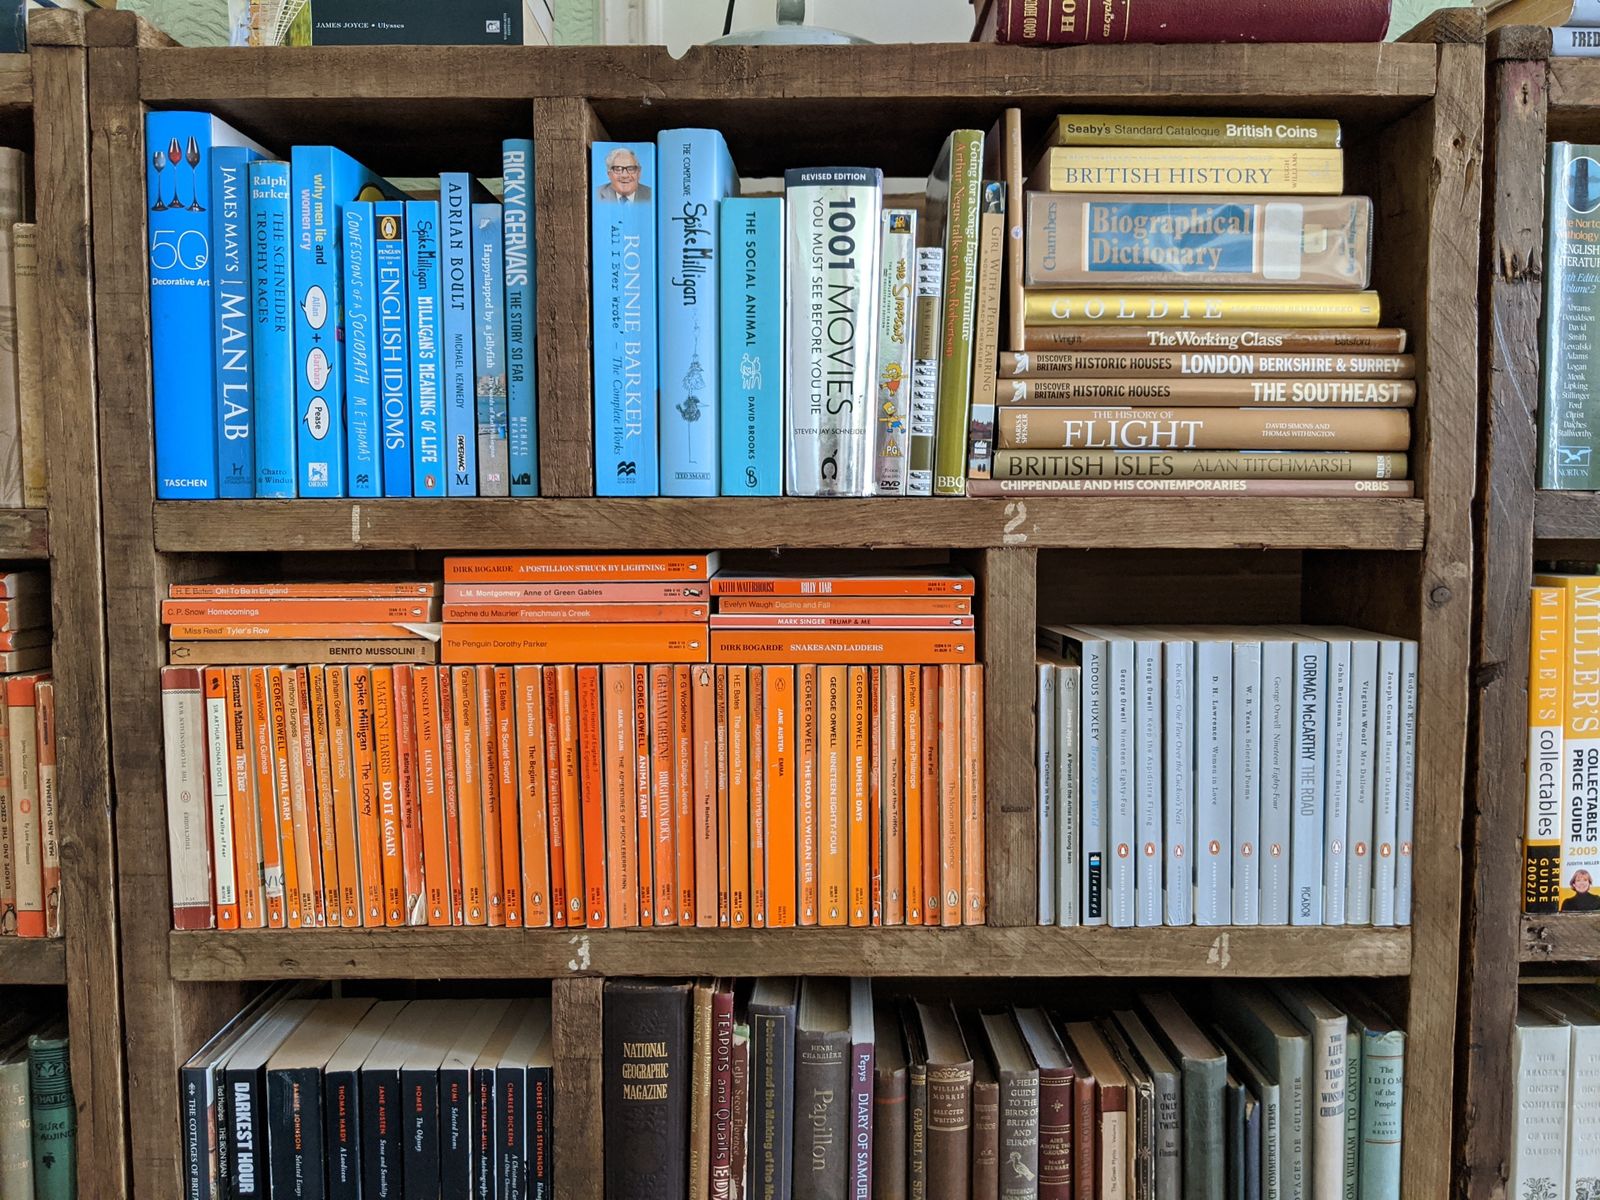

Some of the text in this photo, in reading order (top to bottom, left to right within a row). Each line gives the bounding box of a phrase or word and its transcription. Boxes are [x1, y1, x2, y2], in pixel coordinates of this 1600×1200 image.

[1067, 123, 1318, 138] Seaby's Standard Catalogue British Coins
[253, 176, 287, 188] Ralph
[801, 172, 866, 181] REVISED EDITION
[1065, 167, 1273, 184] BRITISH HISTORY
[311, 174, 328, 265] why men lie and
[503, 151, 528, 287] RICKY GERVAIS
[1092, 206, 1250, 240] Biographical
[448, 182, 465, 311] ADRIAN BOULT
[1092, 237, 1223, 271] Dictionary
[152, 277, 210, 287] Decorative Art
[256, 212, 269, 324] TROPHY RACES
[273, 212, 287, 332] THE SCHNEIDER
[745, 212, 756, 347] THE SOCIAL ANIMAL
[220, 167, 249, 440] JAMES MAY'S MAN LAB
[810, 197, 824, 415] YOU MUST SEE BEFORE YOU DIE
[826, 197, 856, 415] 1001 MOVIES
[623, 235, 642, 439] RONNIE BARKER
[1334, 337, 1371, 347] batsford
[1568, 323, 1587, 331] David
[381, 268, 405, 450] ENGLISH IDIOMS
[454, 333, 465, 409] MICHAEL KENNEDY
[1075, 357, 1172, 370] HISTORIC HOUSES
[1566, 362, 1587, 373] Logan
[417, 296, 438, 463] MILLIGAN'S MEANING OF LIFE
[1073, 385, 1171, 398] HISTORIC HOUSES
[1251, 382, 1401, 403] THE SOUTHEAST
[314, 406, 323, 430] Pease
[747, 425, 755, 460] BROOKS
[1062, 420, 1203, 449] FLIGHT
[1009, 455, 1174, 476] BRITISH ISLES
[1193, 458, 1352, 473] ALAN TITCHMARSH
[164, 479, 208, 487] TASCHEN
[937, 476, 965, 488] BBC
[1000, 479, 1247, 491] CHIPPENDALE AND HIS CONTEMPORARIES
[1354, 481, 1390, 491] ORBIS
[453, 565, 514, 573] DIRK BOGARDE
[329, 647, 416, 656] BENITO MUSSOLINI
[447, 640, 548, 649] The Penguin Dorothy Parker
[1090, 653, 1099, 741] ALDOUS HUXLEY
[1539, 592, 1559, 837] MILLER'S collectables
[272, 676, 291, 821] GEORGE ORWELL ANIMAL FARM
[637, 673, 648, 818] GEORGE ORWELL ANIMAL FARM
[1301, 654, 1318, 817] CORMAC McCARTHY THE ROAD
[45, 777, 54, 817] SUPERMAN
[1571, 749, 1583, 843] PRICE GUIDE
[1587, 747, 1598, 842] COLLECTABLES
[48, 839, 56, 857] MAN
[1568, 846, 1598, 856] 2009
[1090, 869, 1099, 915] flamingo
[1527, 858, 1536, 903] 2002/3
[1539, 858, 1548, 904] GUIDE
[1552, 857, 1561, 902] PRICE
[1300, 886, 1311, 918] PICADOR
[623, 1041, 668, 1058] NATIONAL
[622, 1062, 669, 1080] GEOGRAPHIC
[714, 1012, 731, 1160] TEAPOTS and Quails
[1368, 1076, 1402, 1085] IDIOM
[1379, 1066, 1394, 1074] The
[623, 1083, 668, 1100] MAGAZINE
[1010, 1088, 1036, 1097] GUIDE
[1159, 1102, 1177, 1111] ONLY
[1374, 1099, 1397, 1109] People
[808, 1087, 834, 1172] Papillon
[856, 1054, 870, 1200] Pepys DIARY OF SAMUEL
[1161, 1112, 1177, 1120] LIVE
[189, 1118, 198, 1161] COTTAGES
[233, 1082, 255, 1193] DARKEST HOUR
[1013, 1129, 1031, 1137] AND
[1268, 1103, 1277, 1188] COMMERCIAL TERMS
[191, 1163, 199, 1175] OF
[536, 1134, 544, 1178] STEVENSON
